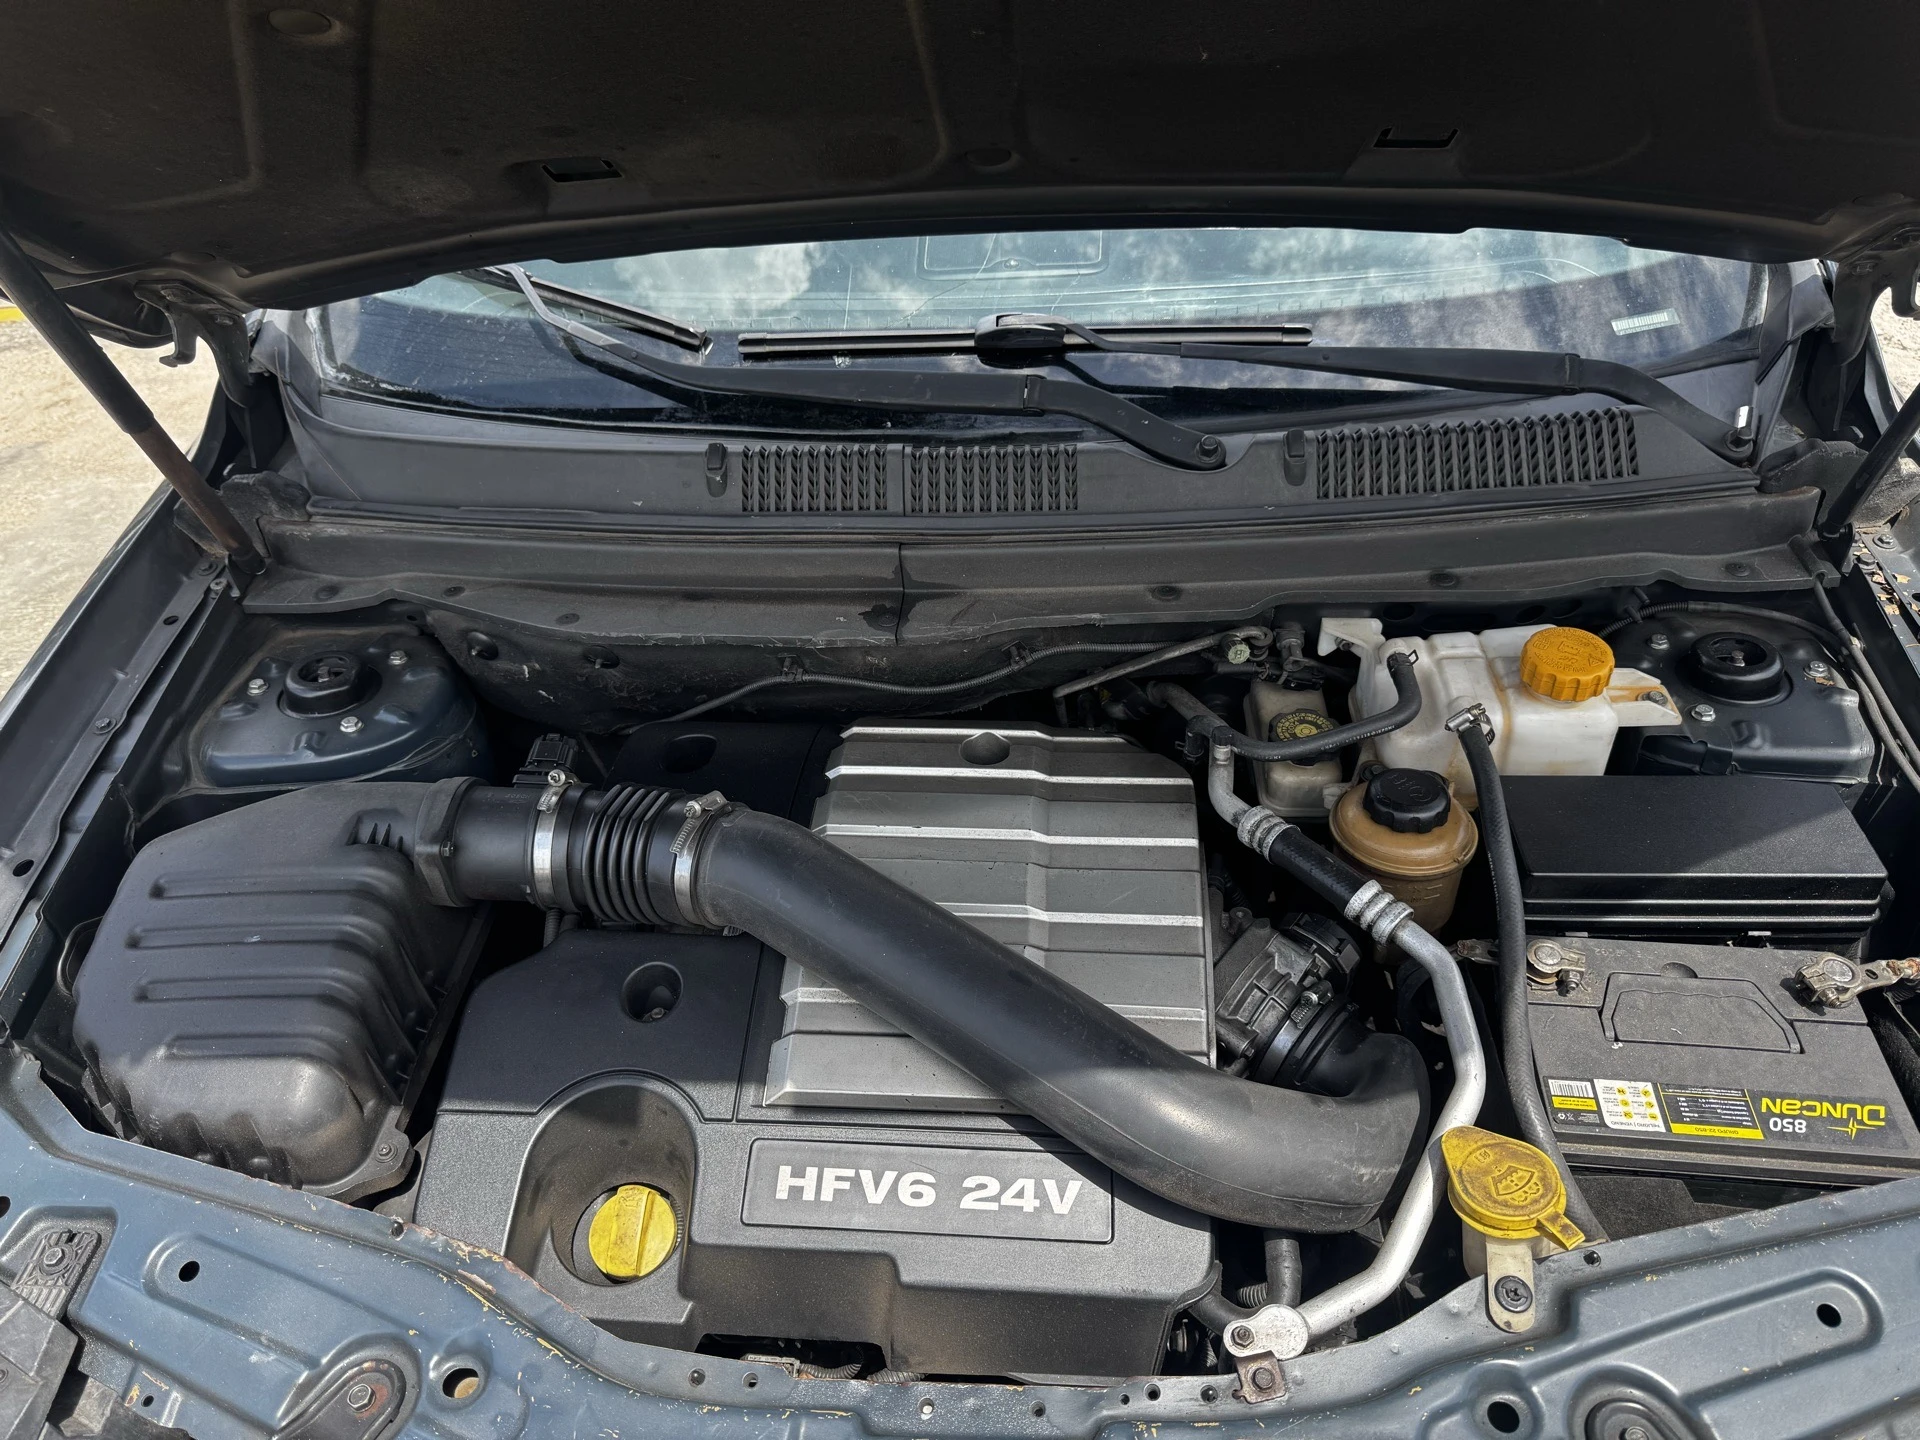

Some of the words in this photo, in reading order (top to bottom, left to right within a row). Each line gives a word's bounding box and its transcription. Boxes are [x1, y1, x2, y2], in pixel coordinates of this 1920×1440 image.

[1761, 1097, 1886, 1127] DUNCAN
[1769, 1117, 1807, 1133] 850
[775, 1165, 937, 1207] HFV6
[959, 1175, 1083, 1215] 24V
